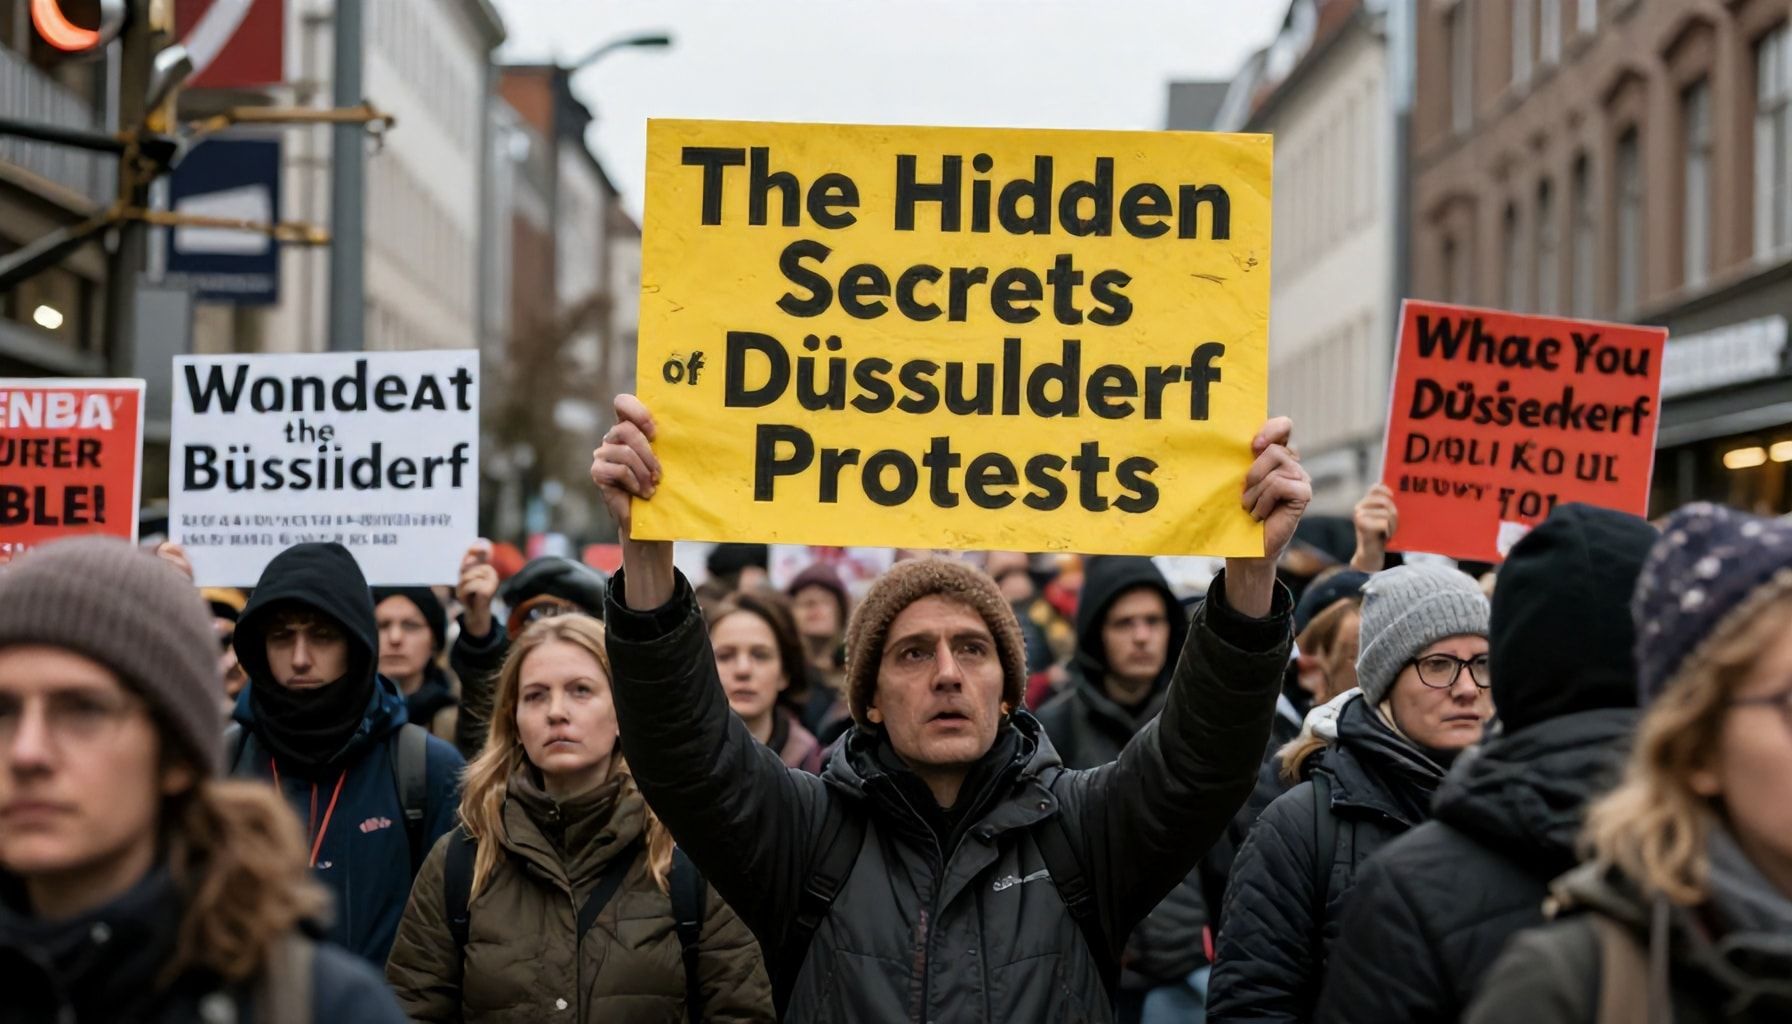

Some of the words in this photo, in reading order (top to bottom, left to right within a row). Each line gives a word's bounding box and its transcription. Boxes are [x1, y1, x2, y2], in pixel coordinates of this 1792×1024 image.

[682, 146, 860, 230] The
[894, 153, 1231, 240] Hidden
[776, 239, 1133, 326] Secrets
[662, 351, 705, 385] of
[724, 331, 1226, 421] Düssulderf
[1571, 331, 1650, 377] You
[284, 418, 335, 443] the
[753, 424, 1160, 514] Protests
